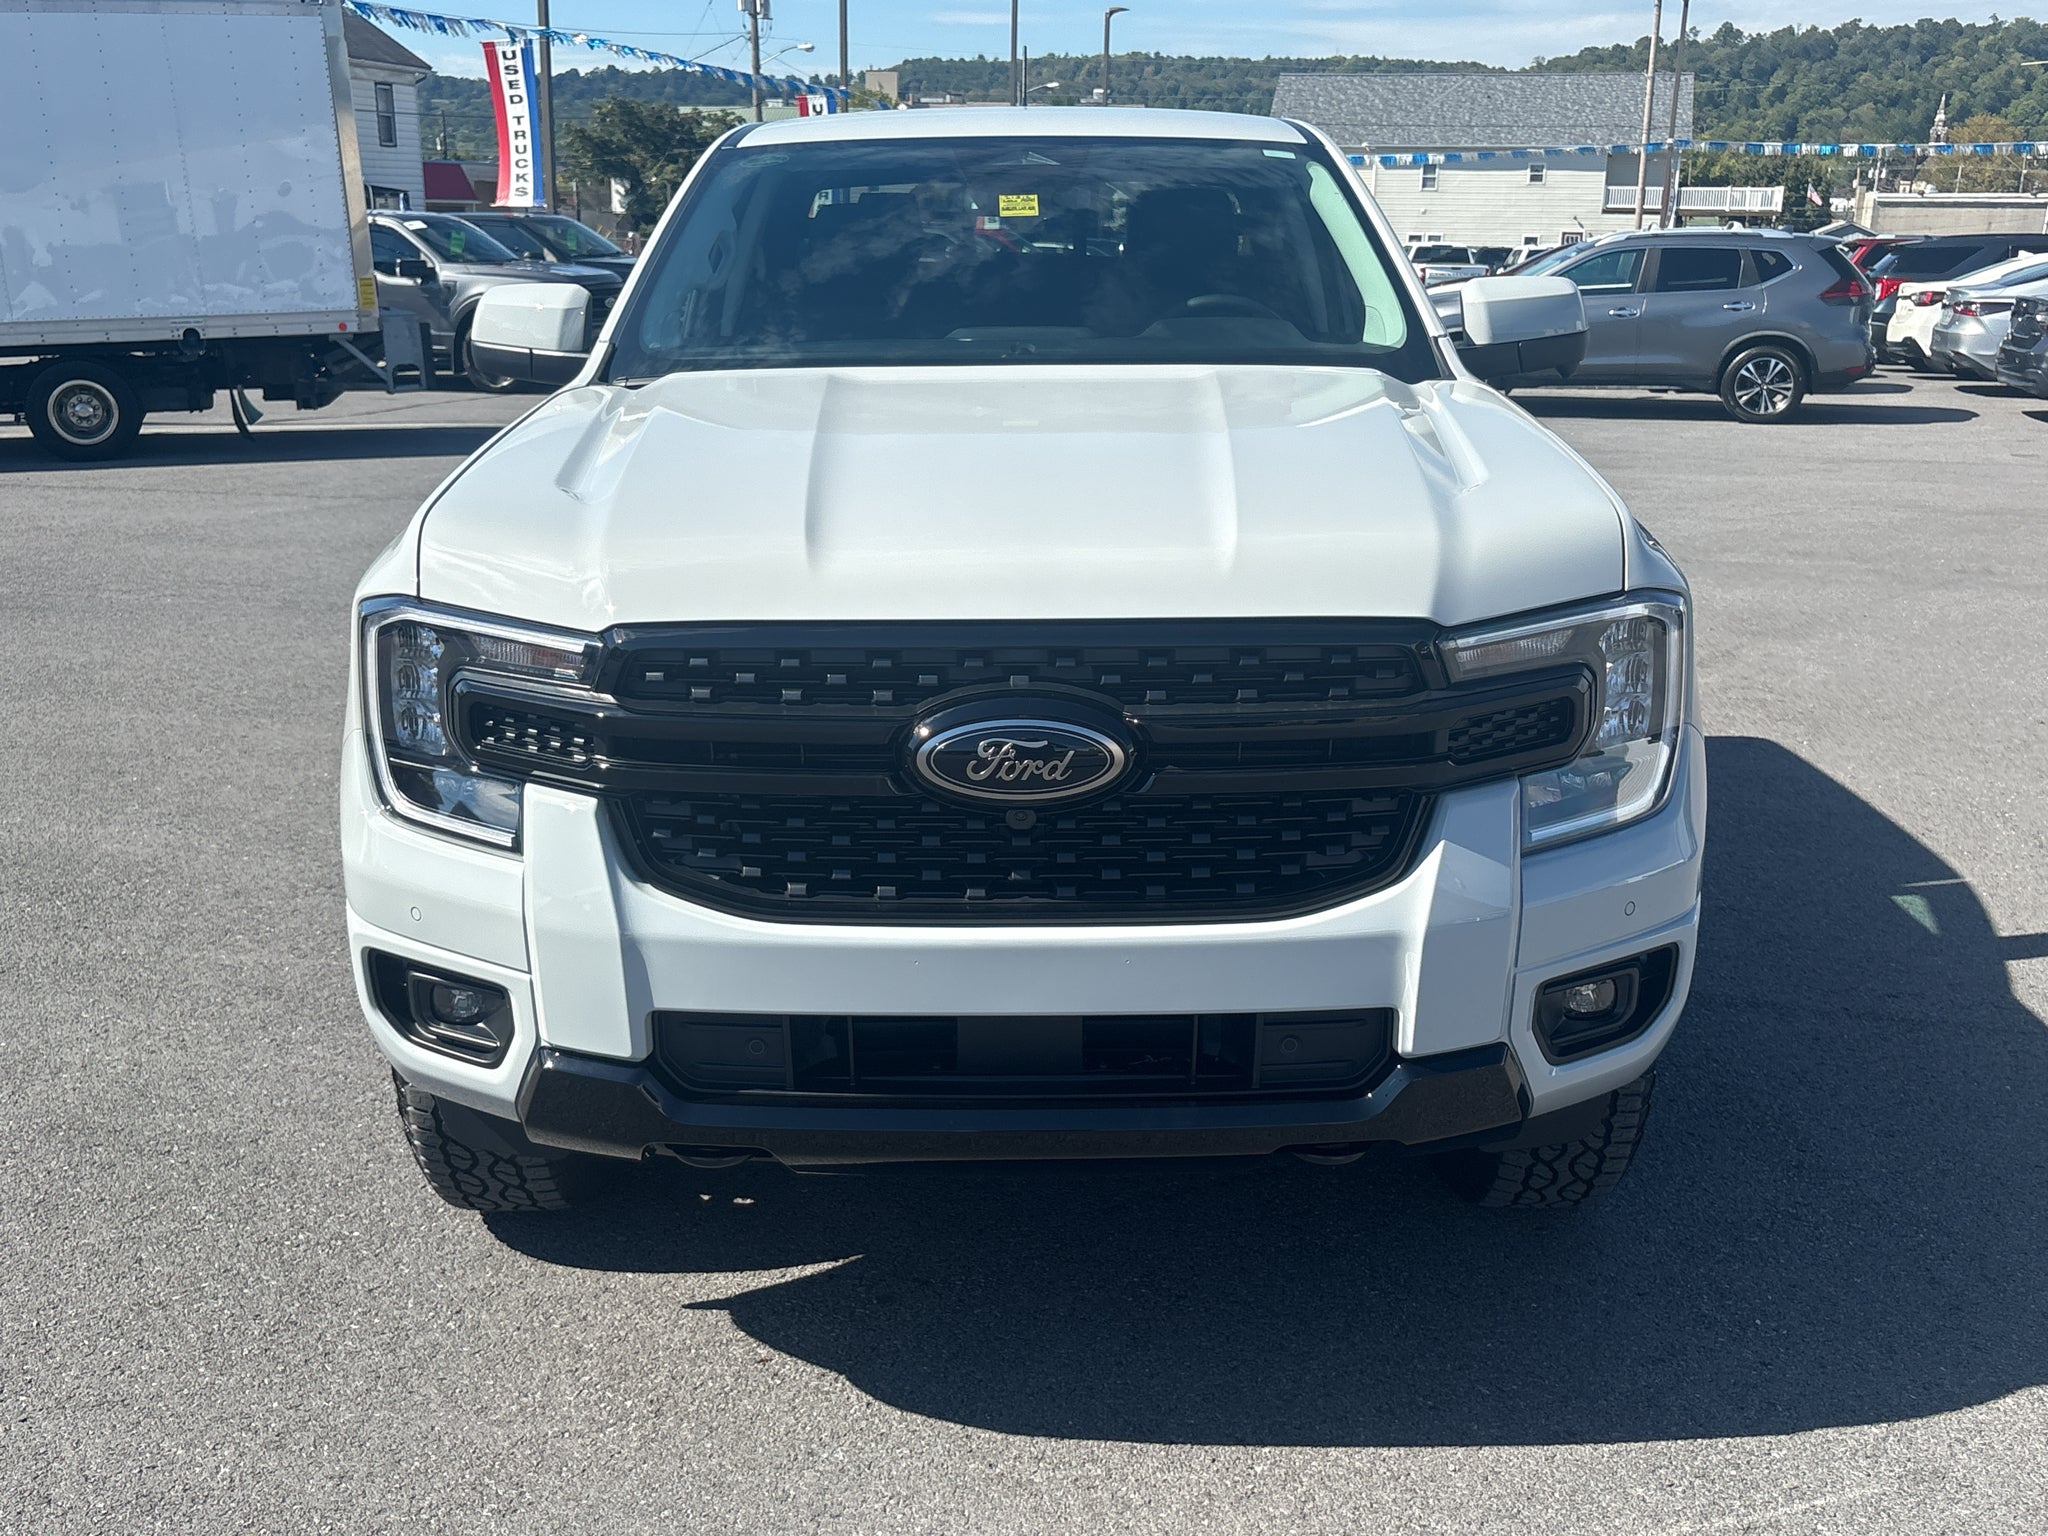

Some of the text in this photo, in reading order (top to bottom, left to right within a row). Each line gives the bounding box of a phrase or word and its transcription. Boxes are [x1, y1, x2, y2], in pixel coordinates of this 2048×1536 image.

[501, 50, 529, 197] USED TRUCKS
[966, 737, 1075, 782] Ford
